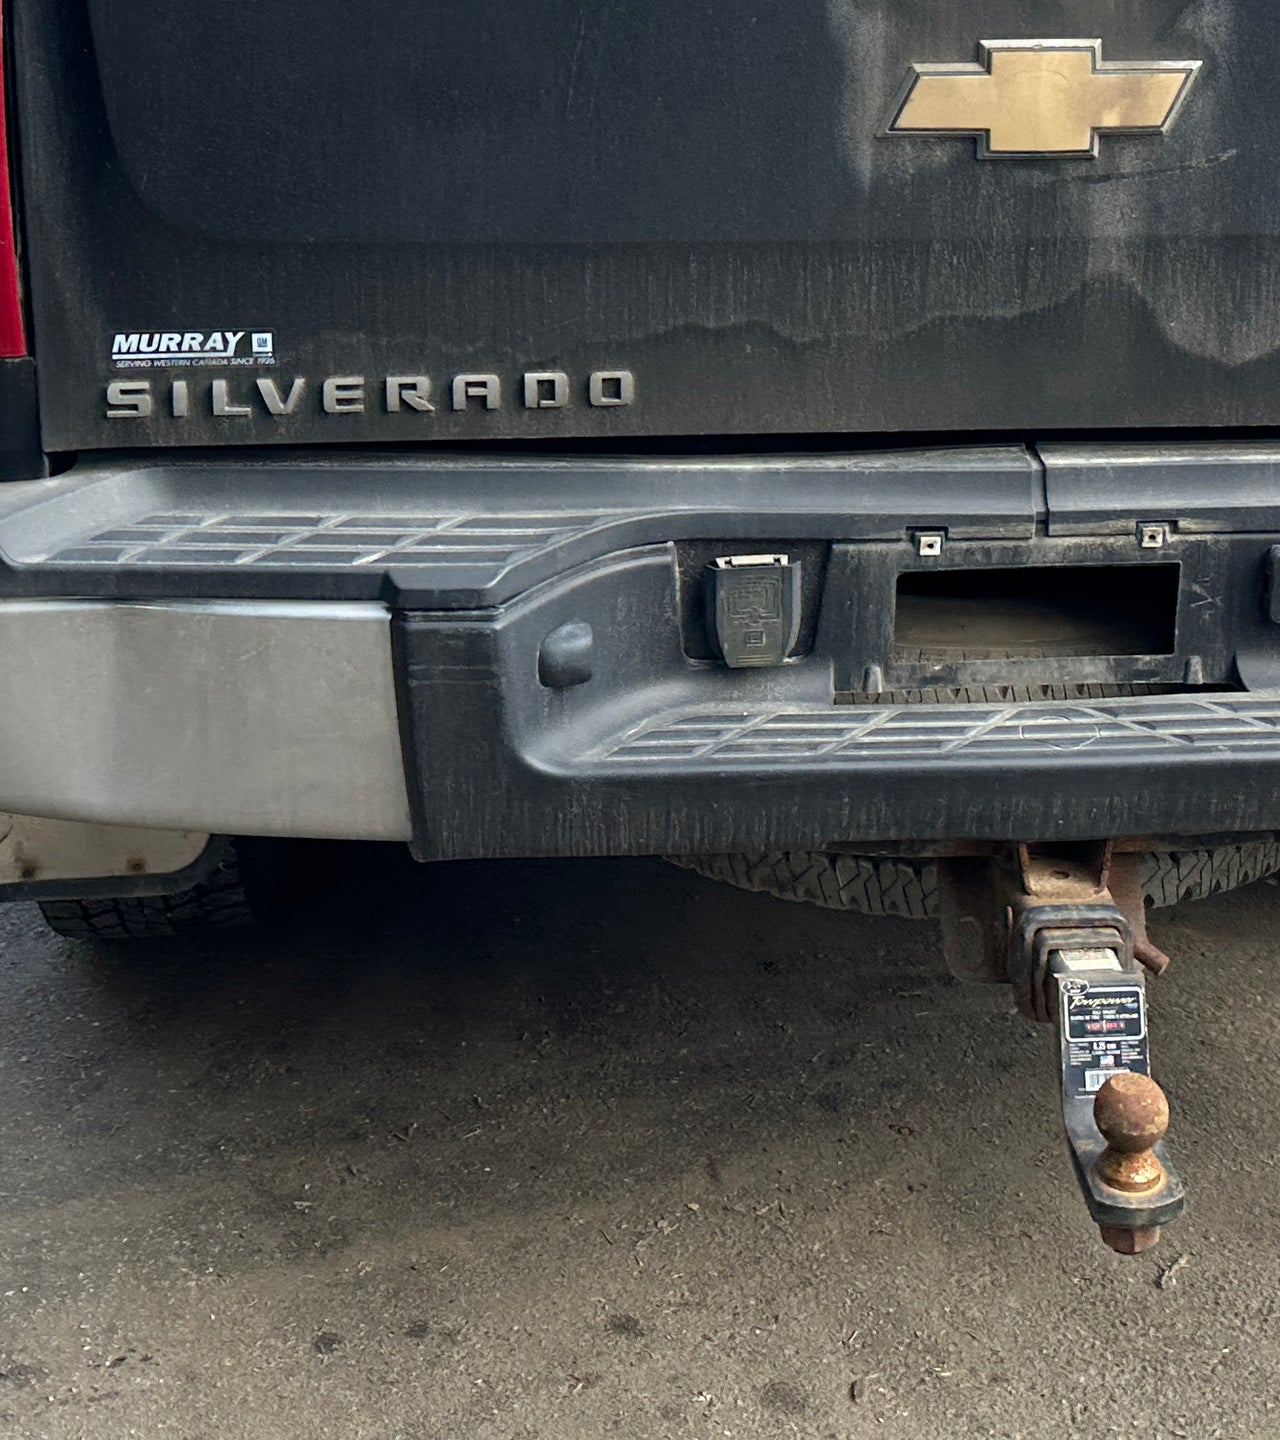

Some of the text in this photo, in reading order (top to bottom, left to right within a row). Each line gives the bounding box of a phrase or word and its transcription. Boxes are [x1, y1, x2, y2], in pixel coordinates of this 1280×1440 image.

[112, 332, 245, 357] MURRAY
[116, 360, 152, 368] SERVING
[153, 359, 191, 367] WESTERN
[192, 358, 228, 366] CANADA
[230, 357, 255, 365] SINCE
[107, 371, 635, 418] SILVERADO
